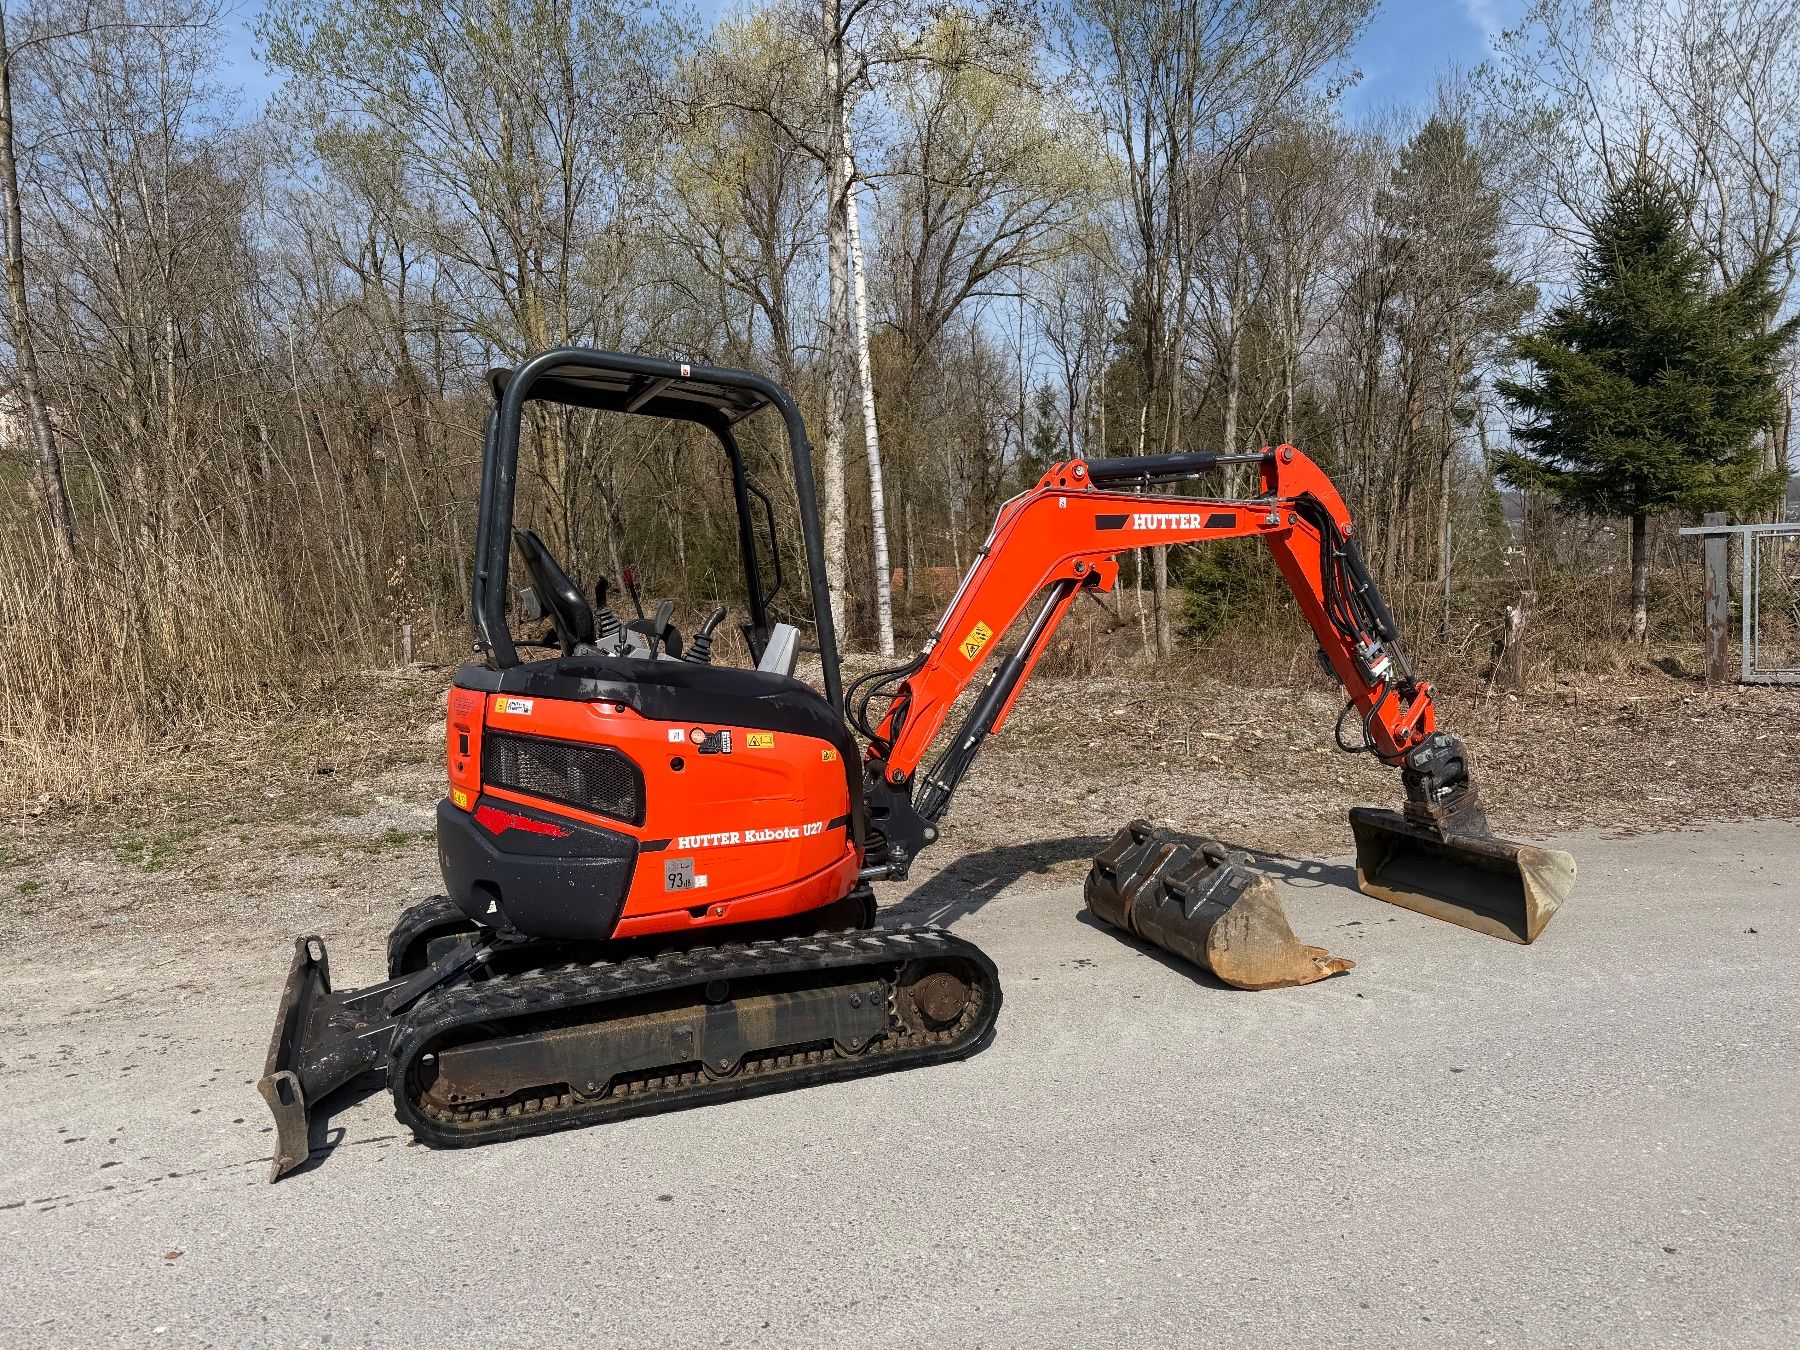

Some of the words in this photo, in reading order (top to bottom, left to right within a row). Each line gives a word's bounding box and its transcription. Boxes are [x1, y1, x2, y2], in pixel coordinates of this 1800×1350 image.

[1133, 514, 1201, 529] HUTTER
[678, 832, 740, 849] HUTTER
[745, 827, 799, 843] Kubota
[803, 821, 823, 837] U27
[668, 872, 683, 888] 93
